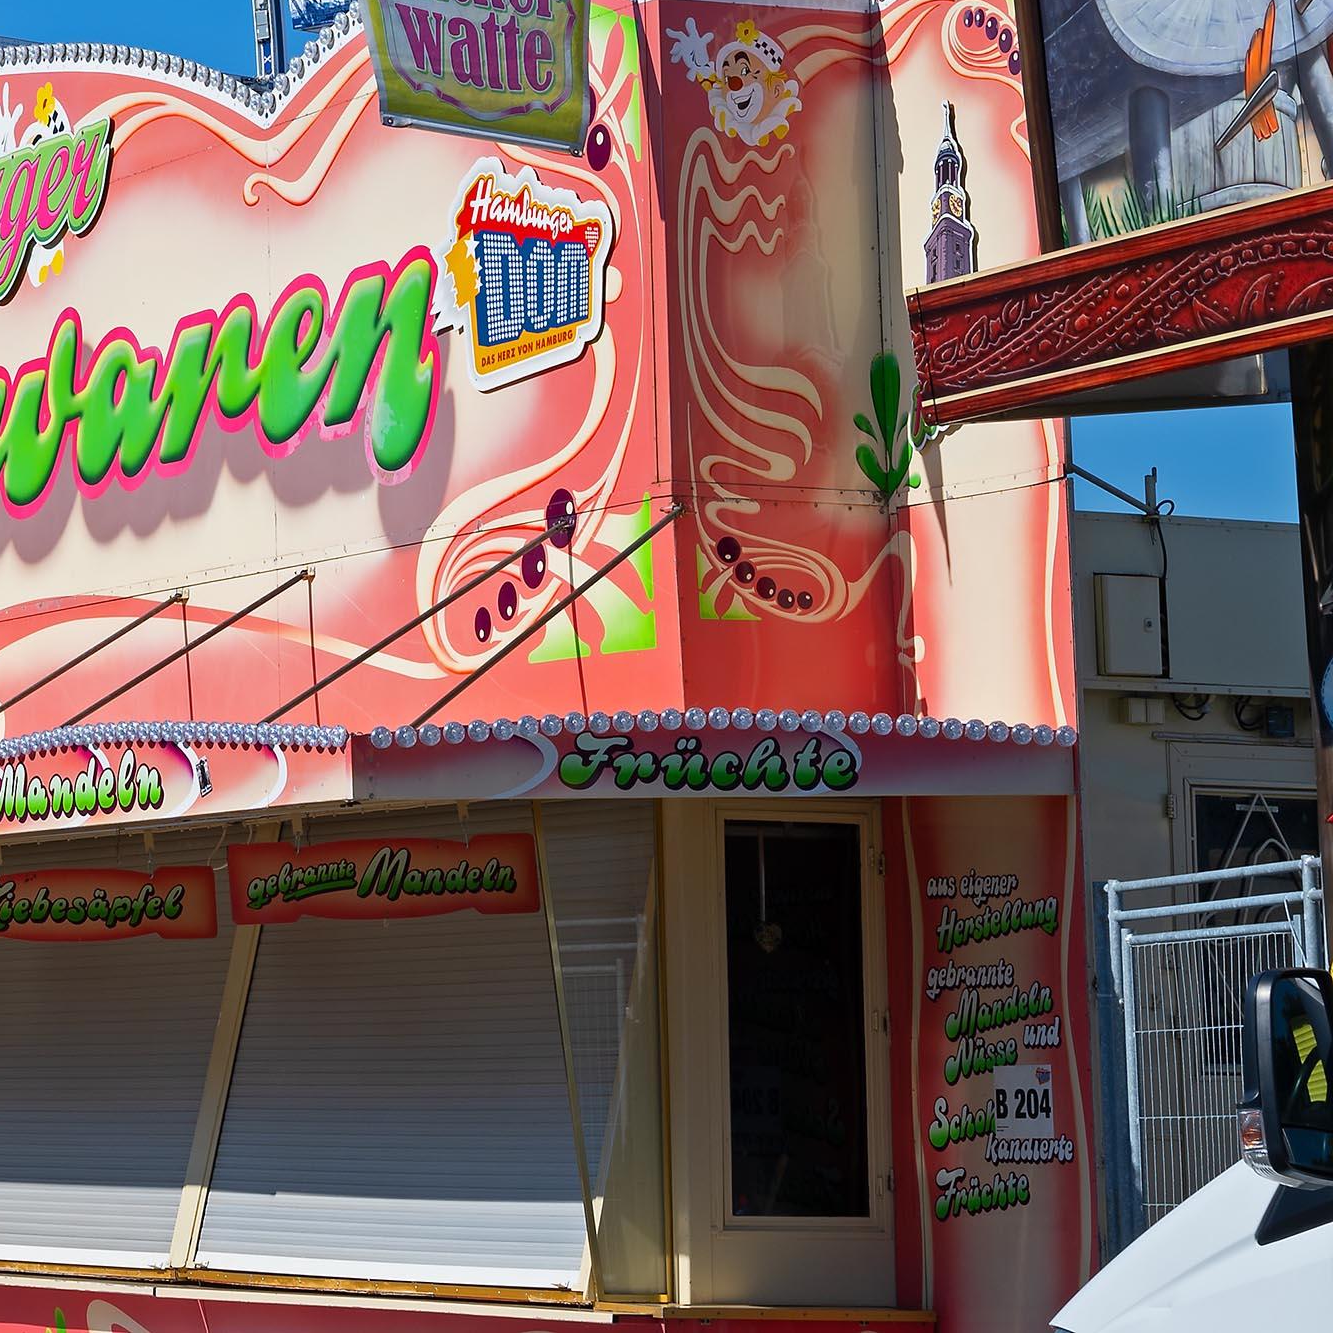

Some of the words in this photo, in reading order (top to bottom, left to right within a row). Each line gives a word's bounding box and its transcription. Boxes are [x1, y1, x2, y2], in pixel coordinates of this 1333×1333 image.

[394, 3, 554, 93] Watte
[470, 178, 574, 240] Hamburger
[483, 233, 590, 343] DOM
[481, 354, 495, 368] DAS
[497, 348, 516, 362] HERZ
[518, 342, 534, 357] VON
[535, 329, 574, 350] HAMBURG
[558, 732, 860, 792] Früchte
[245, 857, 356, 910] gebrannte
[354, 844, 518, 901] Mandeln
[926, 874, 957, 898] aus
[960, 868, 1018, 907] eigener
[936, 895, 1059, 954] Herstellung
[926, 958, 1014, 1000] gebrannte
[945, 980, 1053, 1042] Mandeln
[1022, 1016, 1061, 1048] und
[944, 1036, 1018, 1086] Nüsse
[995, 1088, 1008, 1119] B
[1015, 1088, 1052, 1119] 204
[935, 1166, 1031, 1223] Früchte
